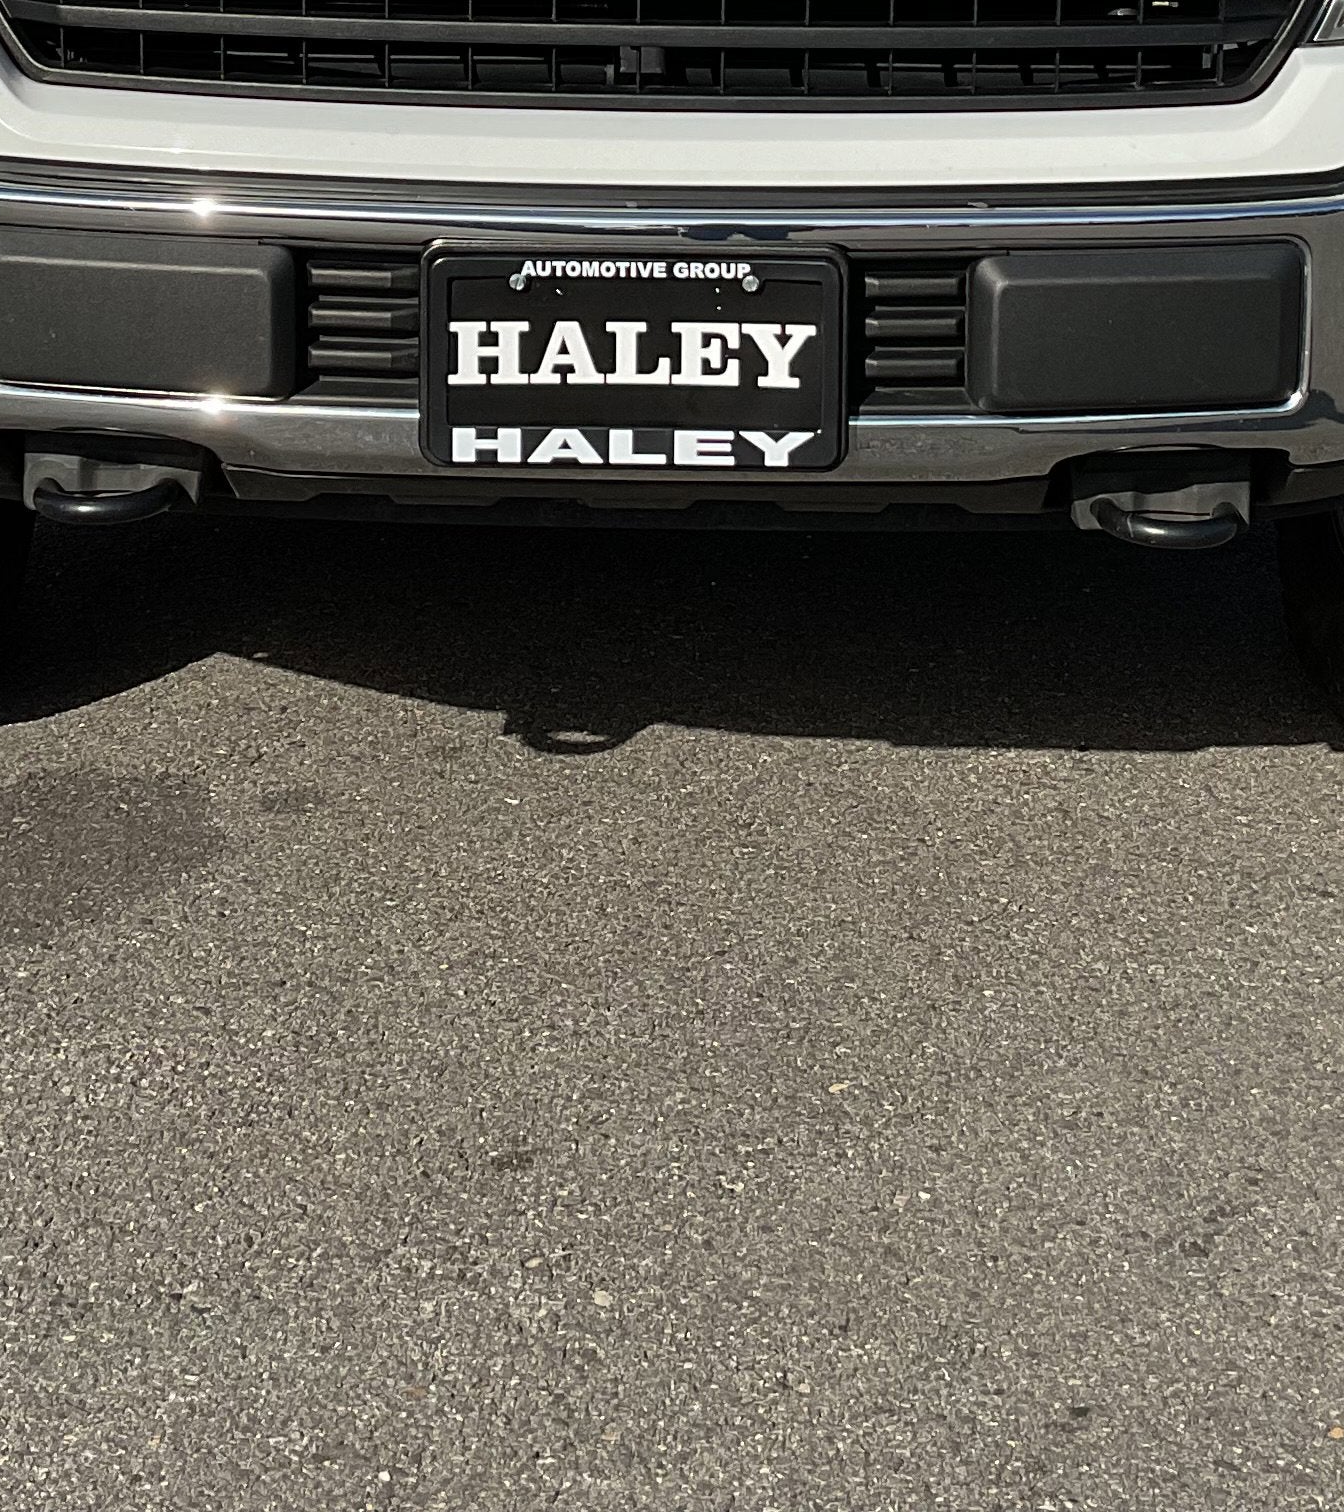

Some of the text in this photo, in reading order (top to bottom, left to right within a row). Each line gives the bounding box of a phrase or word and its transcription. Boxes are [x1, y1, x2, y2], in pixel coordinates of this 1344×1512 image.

[520, 259, 751, 280] AUTOMOTIVE GROUP
[447, 320, 817, 388] HALEY
[451, 427, 815, 467] HALEY
